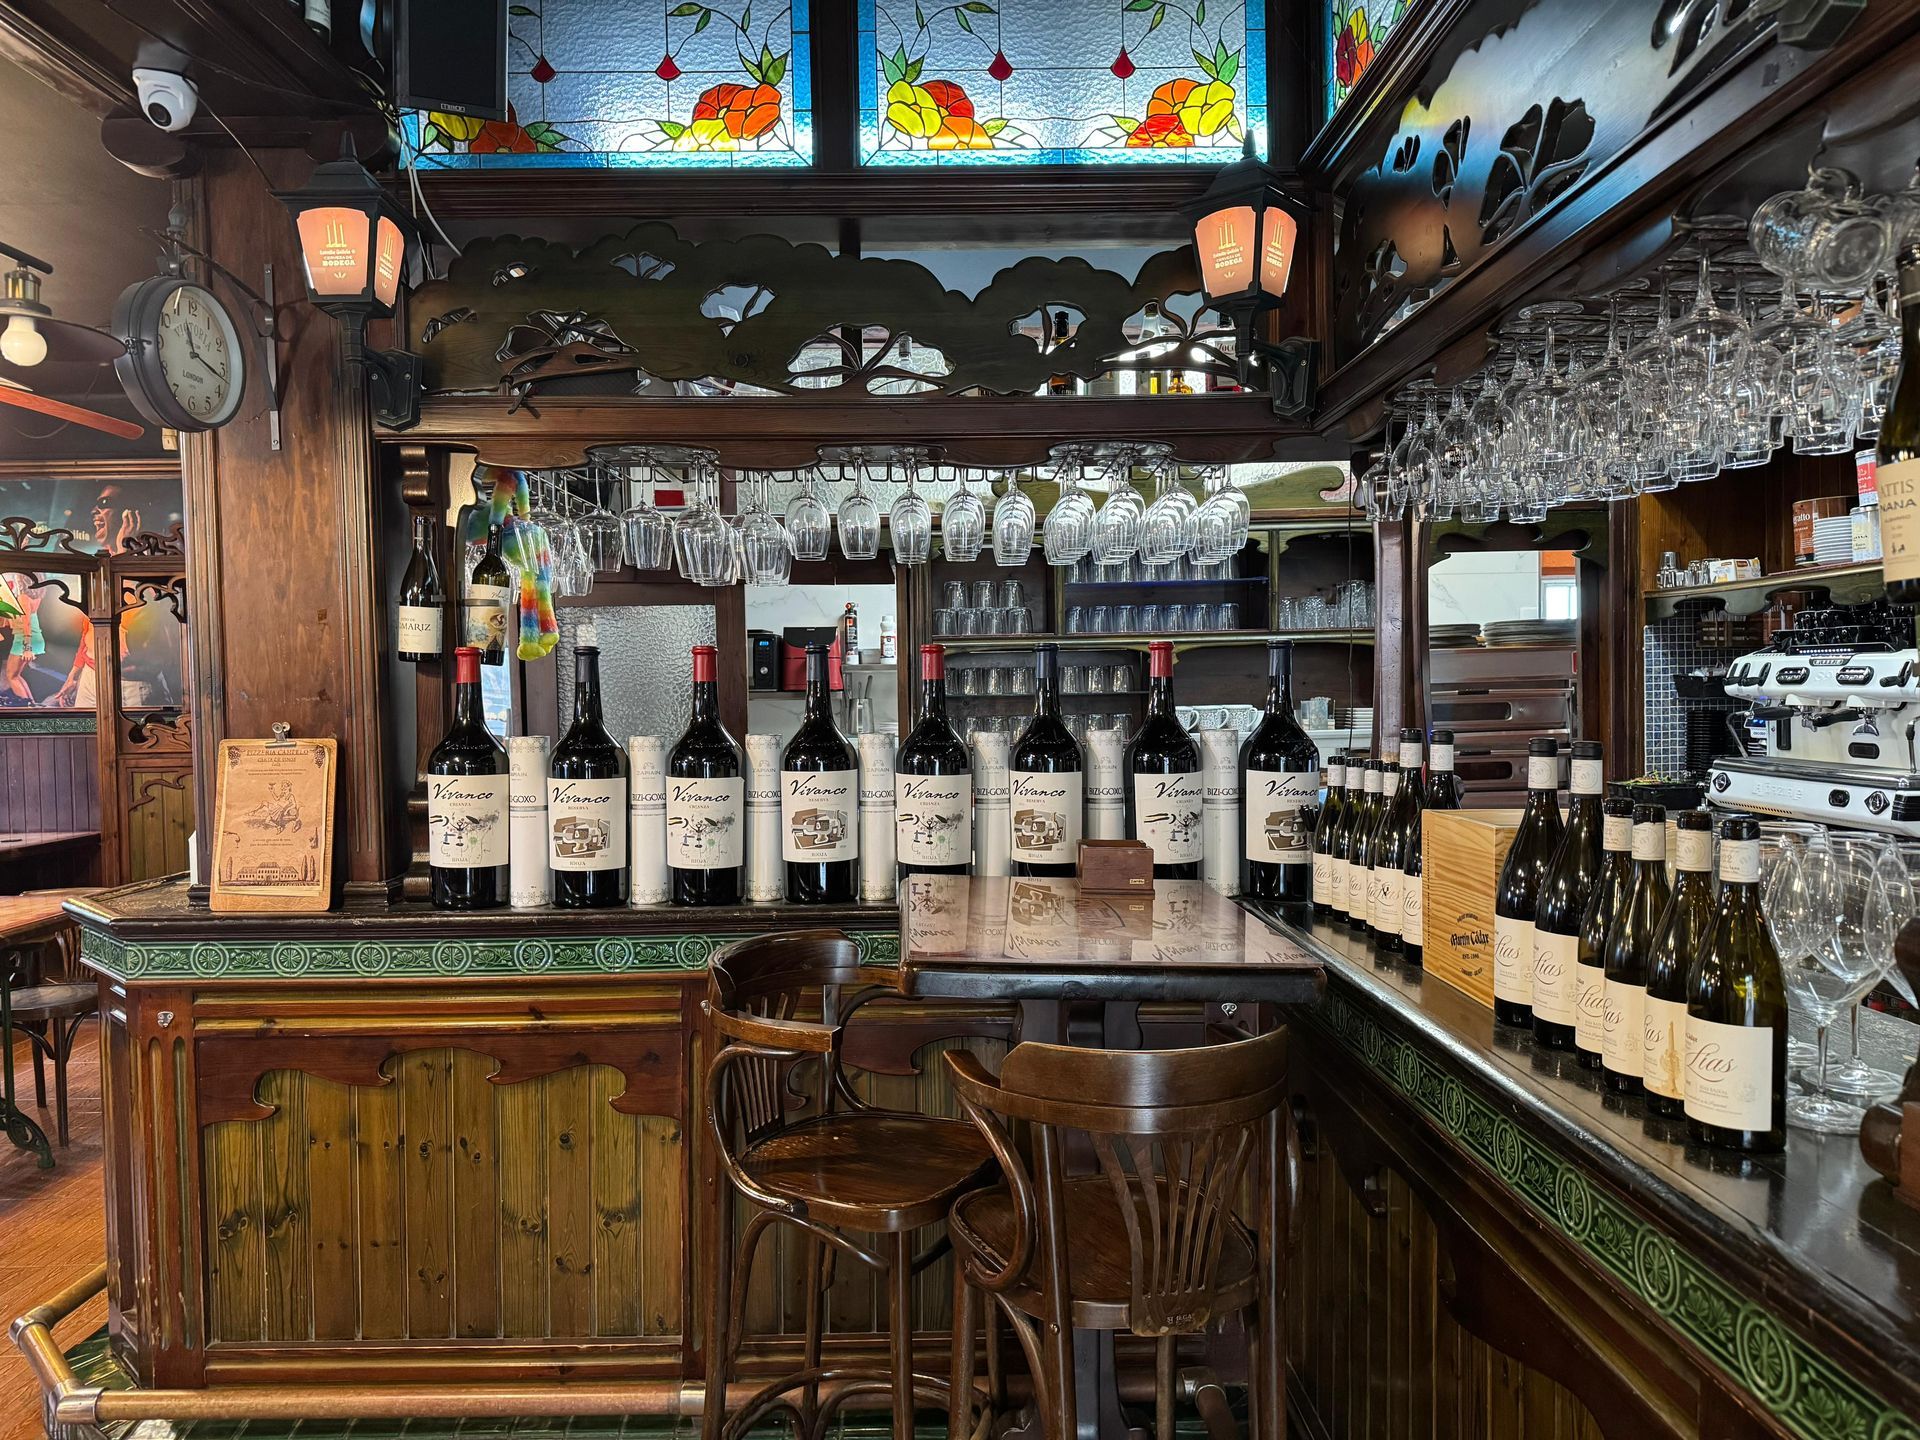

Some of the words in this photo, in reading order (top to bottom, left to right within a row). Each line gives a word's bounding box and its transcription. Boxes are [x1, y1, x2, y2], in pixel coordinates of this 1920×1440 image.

[322, 259, 355, 267] BODEGA
[1214, 256, 1243, 269] BODEGA
[188, 300, 198, 317] 12
[161, 312, 171, 328] 10
[207, 316, 211, 330] 1
[216, 336, 222, 352] 2
[182, 368, 204, 385] LONDON
[219, 362, 226, 378] 3
[214, 383, 223, 398] 4
[187, 395, 196, 411] 6
[204, 396, 212, 413] 5
[433, 779, 495, 800] Vivanco
[552, 783, 611, 804] Vivanco
[672, 781, 731, 803] Vivanco
[790, 775, 848, 796] Vivanco
[903, 778, 960, 800] Vivanco
[1012, 775, 1067, 797] Vivanco
[512, 794, 537, 803] -GOXO
